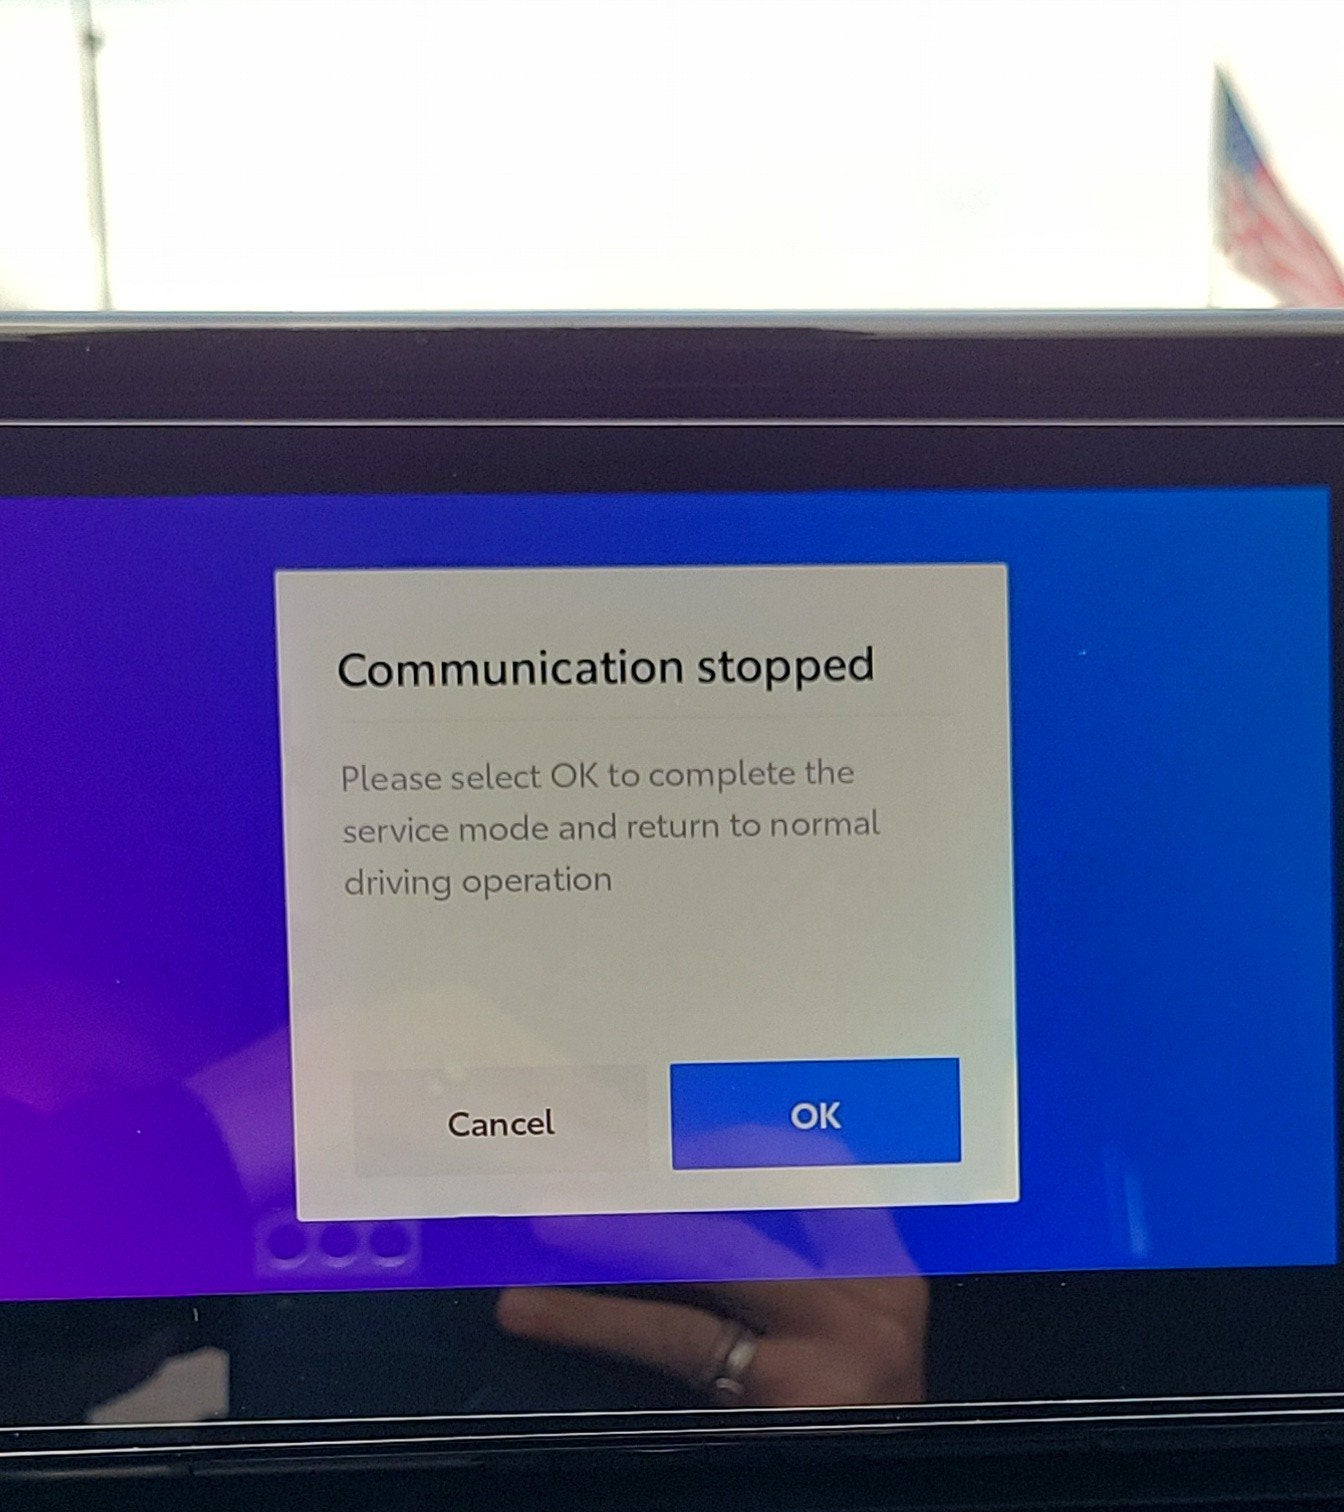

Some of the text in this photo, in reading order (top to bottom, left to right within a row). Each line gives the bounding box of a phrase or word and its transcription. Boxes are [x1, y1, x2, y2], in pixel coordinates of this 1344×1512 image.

[338, 646, 875, 691] Communication stopped
[341, 759, 855, 795] Please select OK to complete the
[342, 808, 881, 845] service mode and return to normal
[344, 866, 613, 901] driving operation
[448, 1108, 555, 1139] Cancel
[789, 1101, 842, 1131] OK
